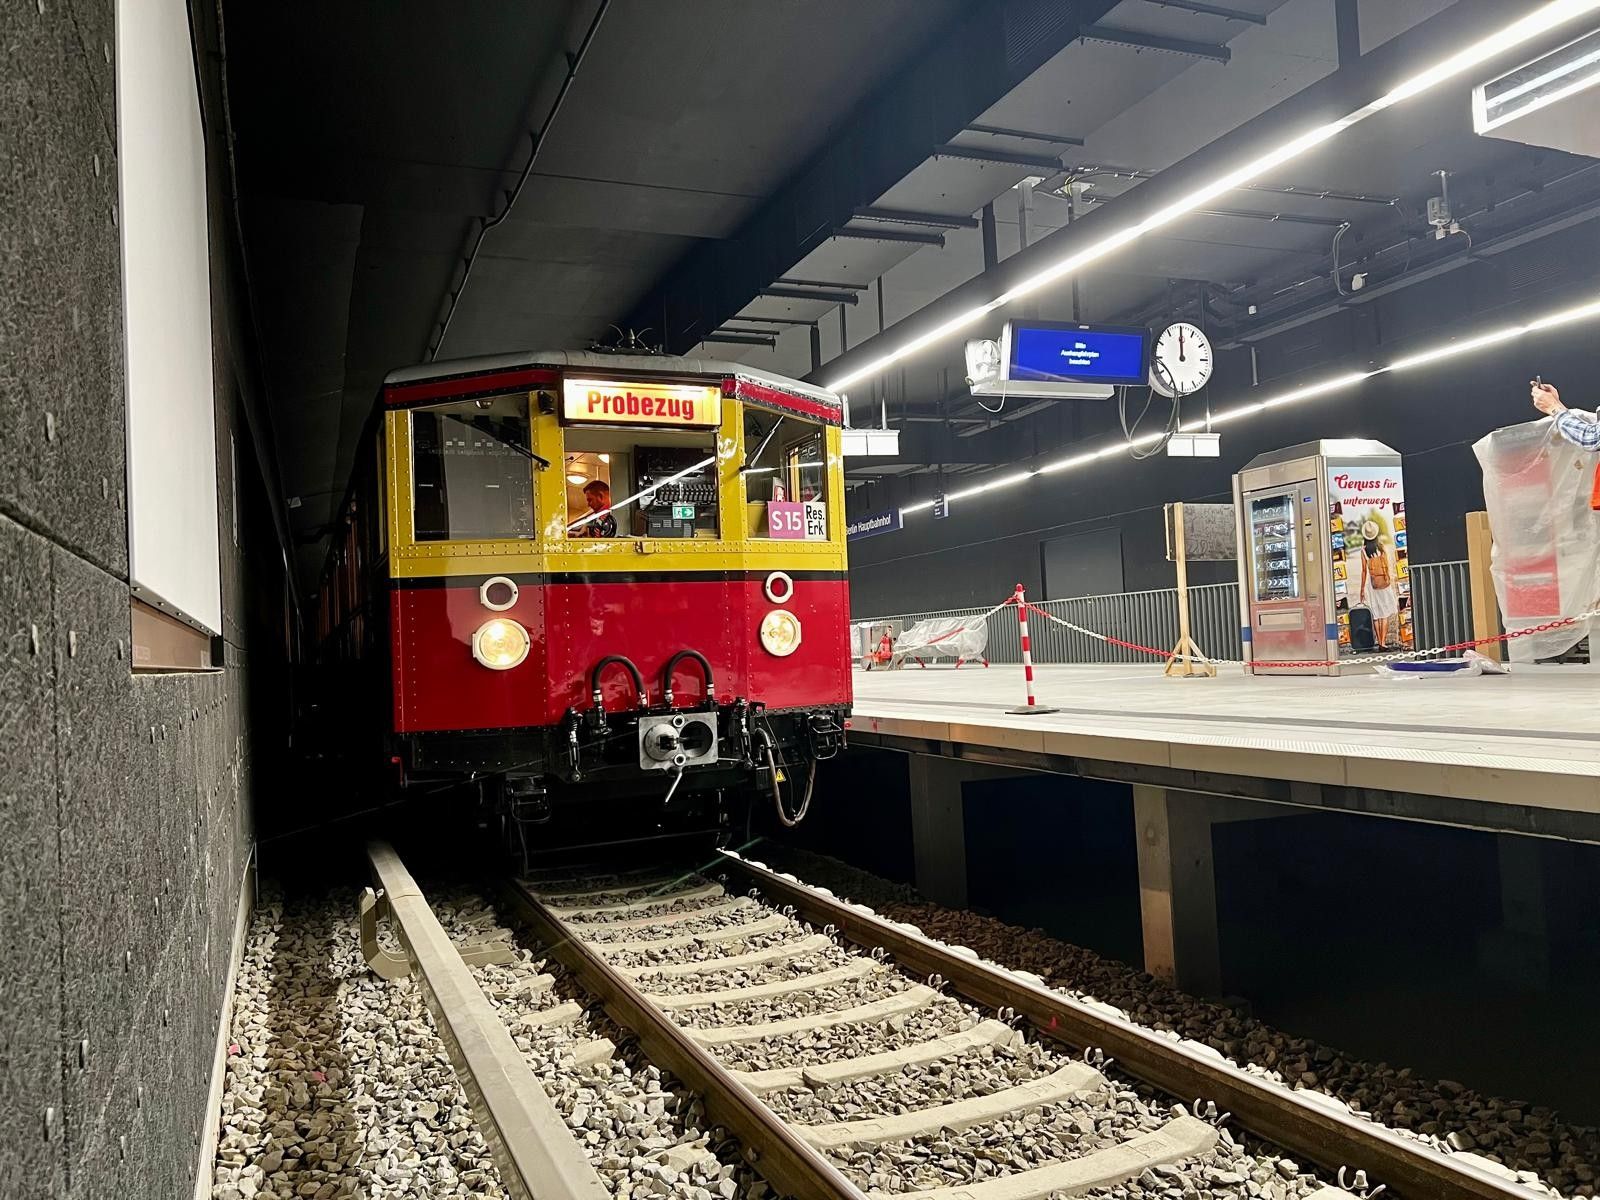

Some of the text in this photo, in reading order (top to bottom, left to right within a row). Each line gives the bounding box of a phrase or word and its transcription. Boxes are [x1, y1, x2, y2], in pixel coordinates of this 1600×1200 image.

[587, 391, 695, 420] Probezug
[1334, 474, 1398, 491] Genuss für
[1343, 496, 1391, 510] unterwegs
[805, 504, 825, 520] Res.
[807, 520, 824, 536] Erk
[857, 513, 891, 533] Hauptbahnhof
